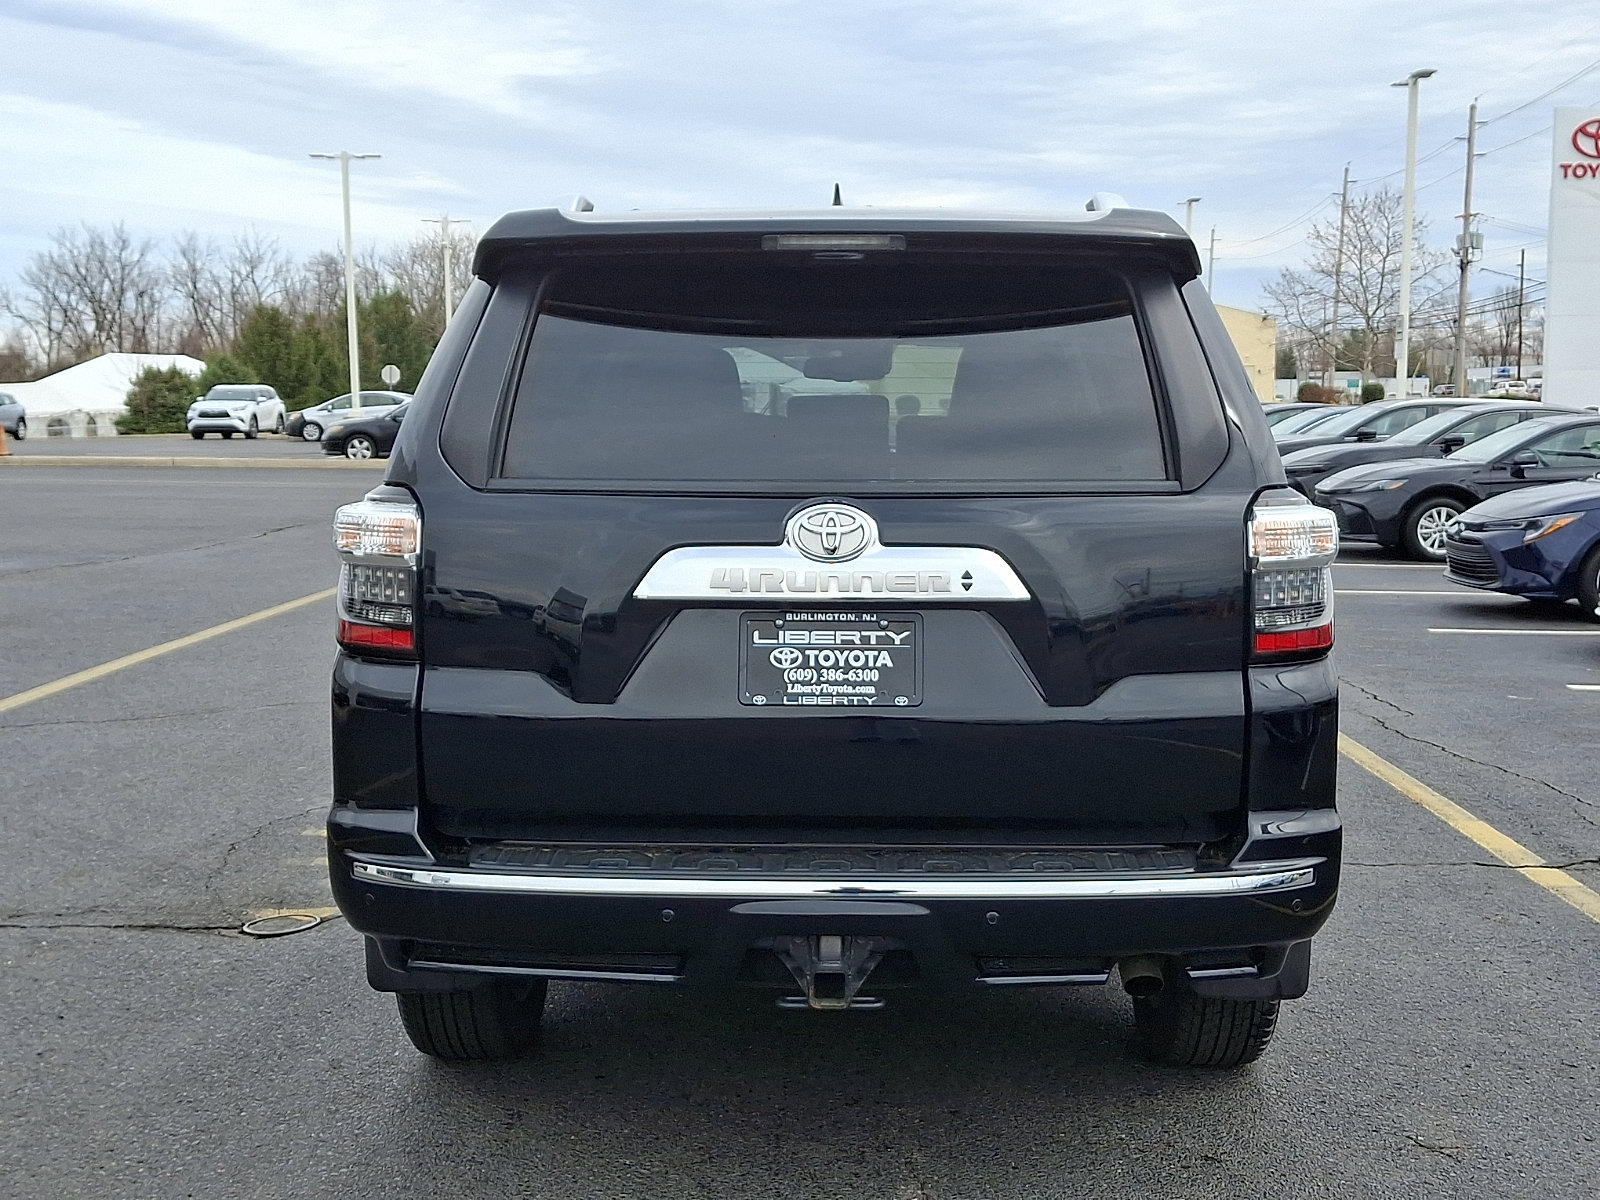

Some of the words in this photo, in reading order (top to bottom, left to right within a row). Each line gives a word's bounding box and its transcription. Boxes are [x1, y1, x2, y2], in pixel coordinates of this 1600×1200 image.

[786, 613, 858, 621] BURLINGTON,
[863, 613, 877, 621] NJ
[753, 630, 911, 645] LIBERTY
[805, 650, 893, 667] TOYOTA
[783, 669, 817, 683] (609)
[820, 669, 879, 681] 386-6300
[787, 683, 875, 695] LibertyToyota.com
[783, 696, 877, 705] LIBERTY
